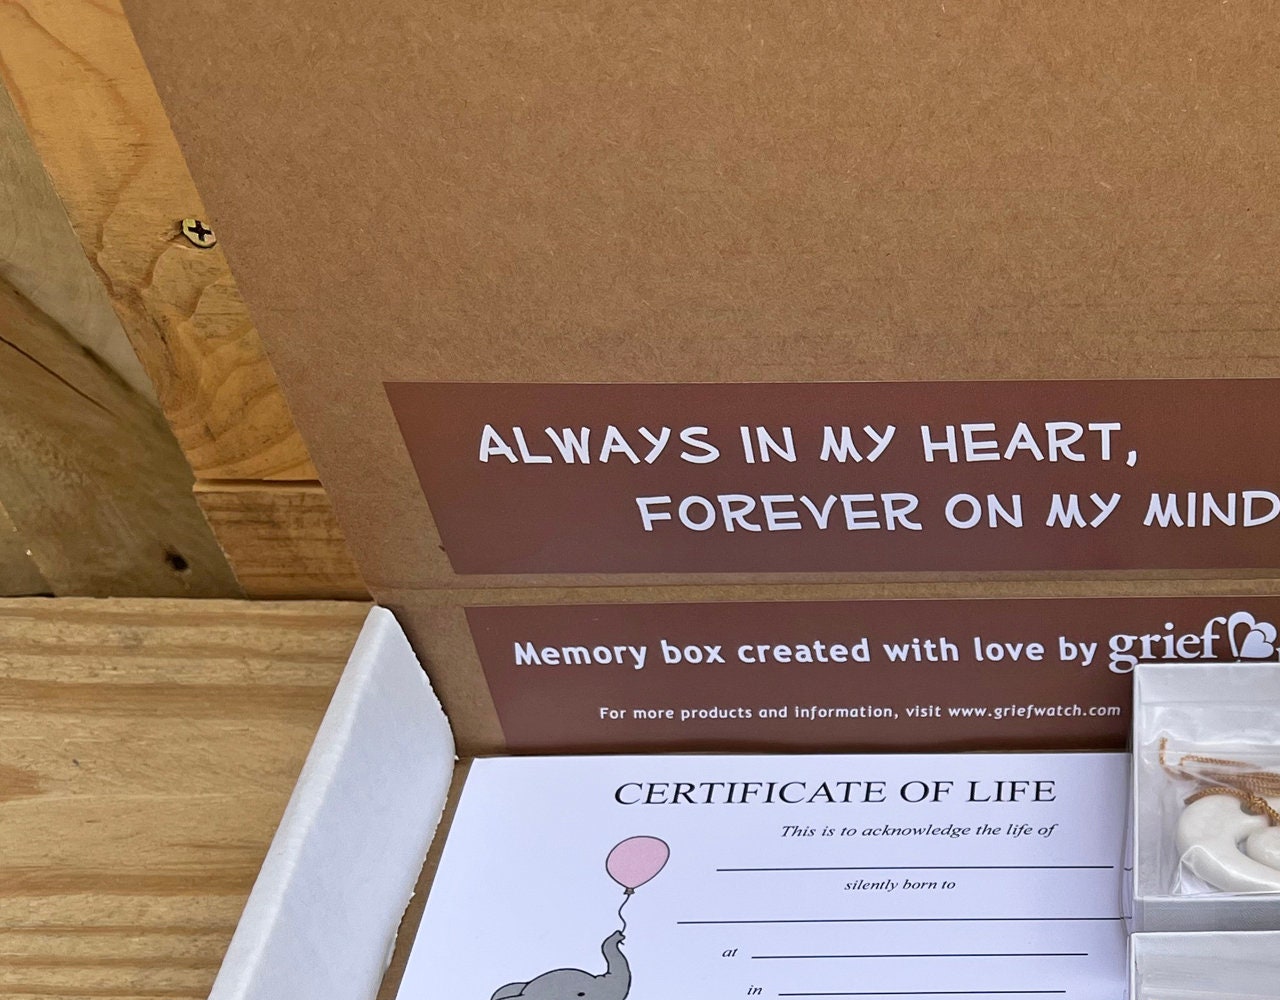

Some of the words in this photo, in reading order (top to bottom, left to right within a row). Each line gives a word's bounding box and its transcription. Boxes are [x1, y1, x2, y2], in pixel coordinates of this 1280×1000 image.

[479, 424, 720, 465] ALWAYS
[740, 426, 797, 464] IN
[819, 425, 896, 463] MY
[920, 421, 1137, 467] HEART,
[635, 492, 923, 532] FOREVER
[944, 493, 1023, 529] ON
[1045, 492, 1121, 529] MY
[514, 642, 647, 670] Memory
[660, 639, 726, 664] box
[737, 637, 871, 663] created
[882, 637, 959, 662] with
[973, 636, 1045, 662] love
[1058, 636, 1098, 667] by
[1108, 616, 1227, 674] grief
[600, 707, 627, 720] For
[633, 709, 674, 719] more
[680, 706, 753, 722] products
[758, 705, 788, 718] and
[794, 705, 899, 721] information,
[905, 705, 941, 718] visit
[948, 704, 1121, 720] www.griefwatch.com
[614, 781, 887, 805] CERTIFICATE
[900, 781, 954, 803] OF
[968, 780, 1056, 802] LIFE
[782, 825, 815, 837] This
[821, 825, 834, 837] is
[840, 827, 857, 837] to
[861, 823, 971, 838] acknowledge
[975, 823, 1002, 836] the
[1006, 823, 1033, 837] life
[1037, 823, 1057, 837] of
[844, 878, 898, 892] silently
[902, 879, 938, 890] born
[941, 881, 956, 889] to
[721, 948, 738, 958] at
[747, 984, 763, 996] in
